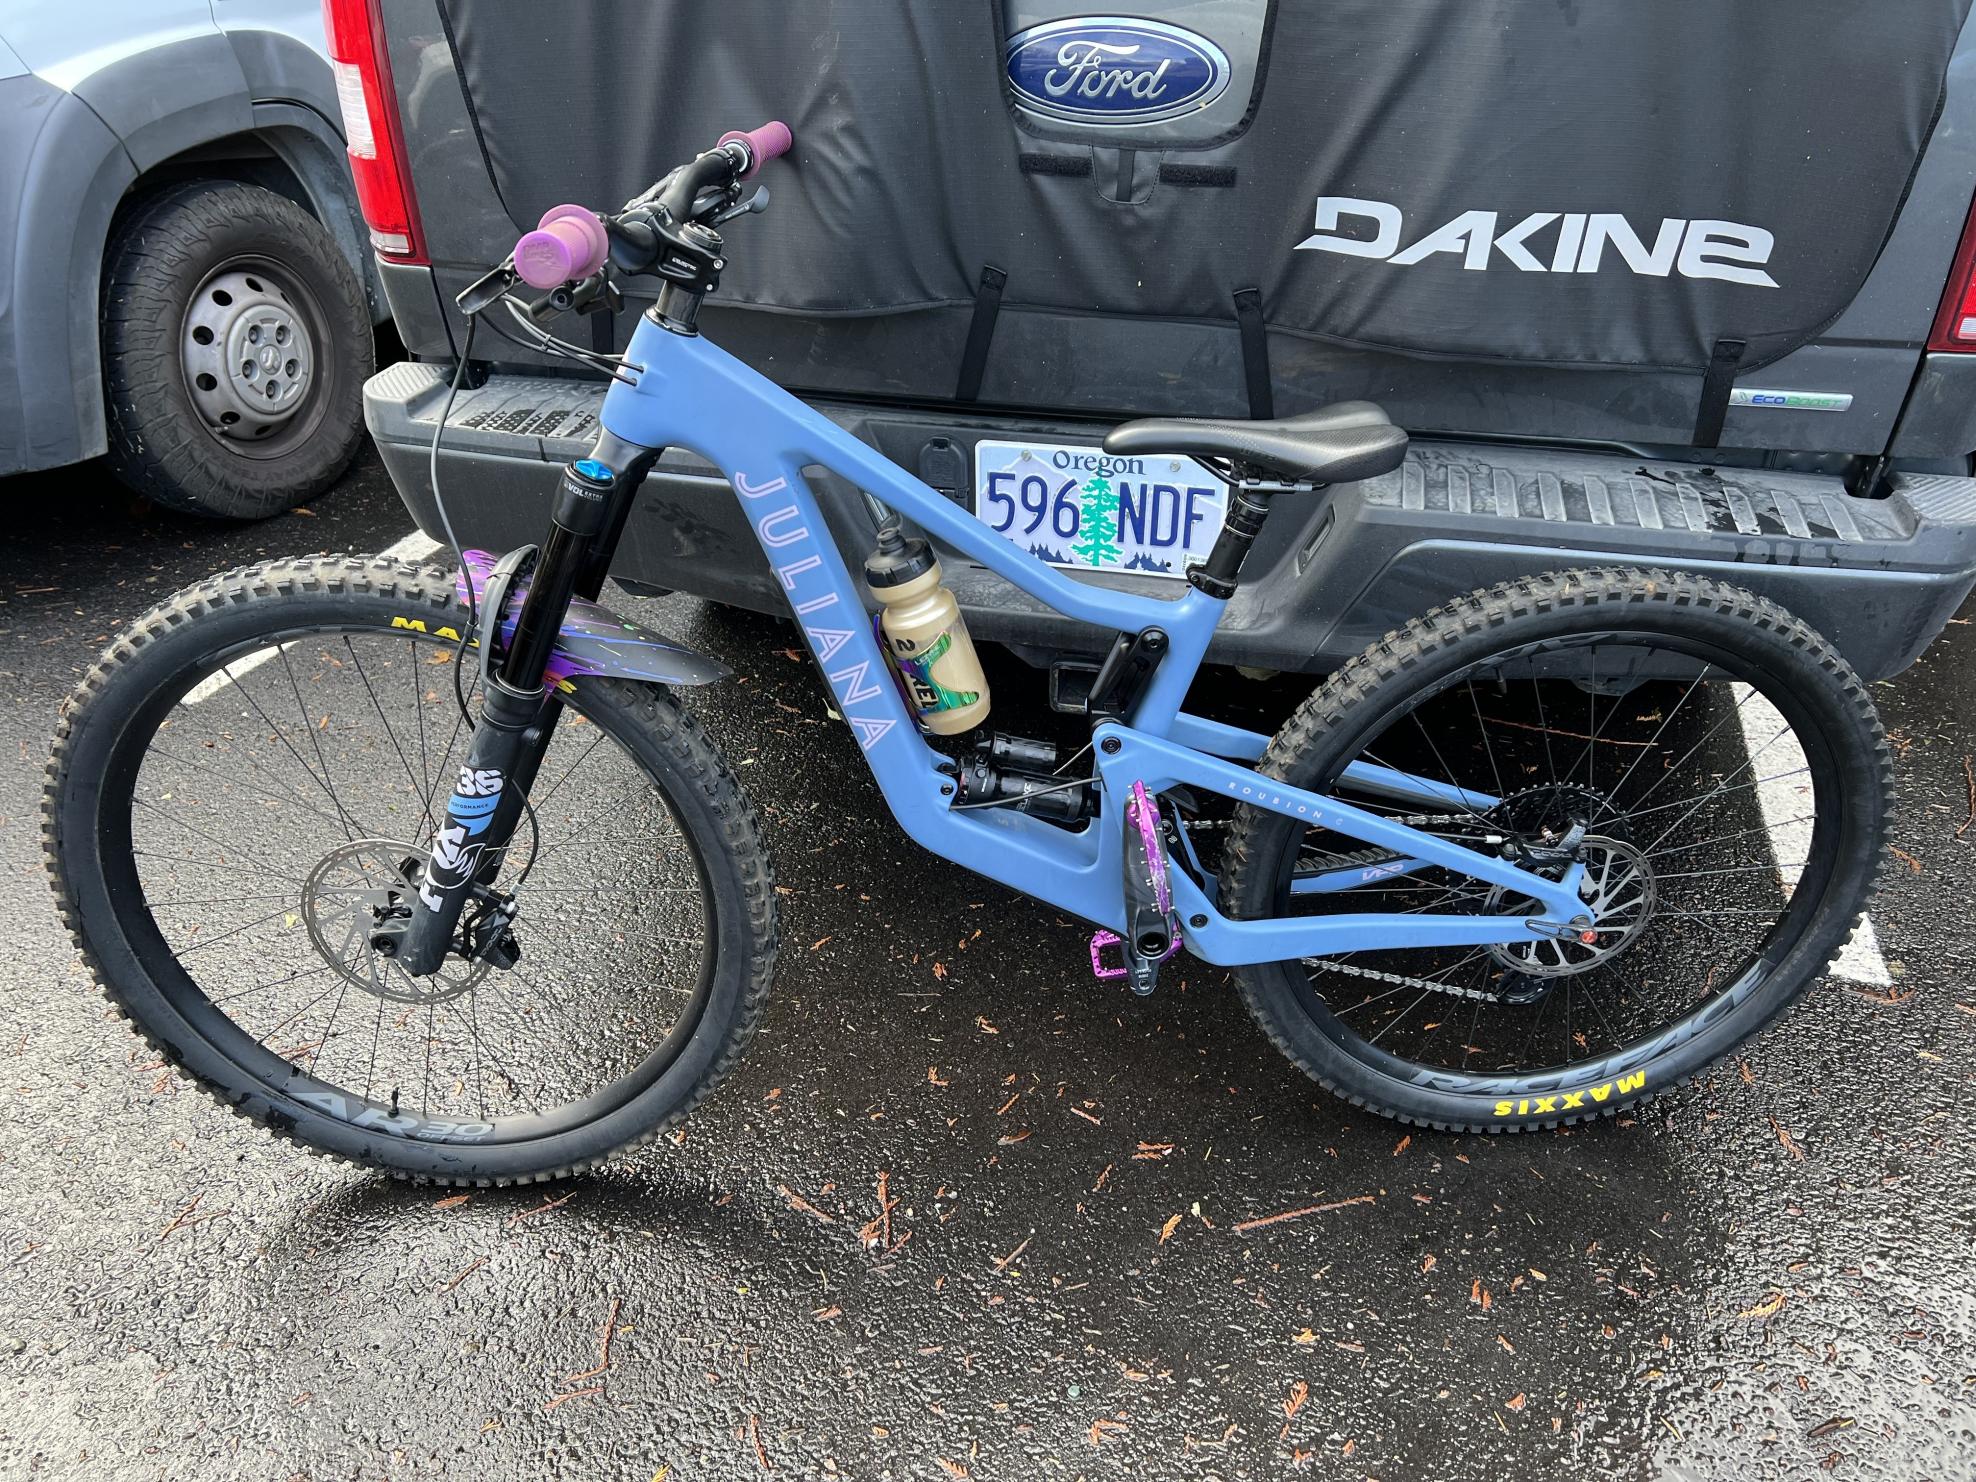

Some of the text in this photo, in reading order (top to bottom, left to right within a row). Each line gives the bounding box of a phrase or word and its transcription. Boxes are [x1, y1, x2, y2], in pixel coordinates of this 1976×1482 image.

[1044, 40, 1171, 100] Ford
[1293, 196, 1781, 288] DAKINE
[1052, 449, 1148, 478] Oregon
[988, 472, 1216, 549] 596 NDF
[735, 471, 897, 750] JULIANA
[456, 765, 504, 796] 36
[1228, 781, 1323, 819] ROUBION
[1494, 1070, 1645, 1117] MAXXIS
